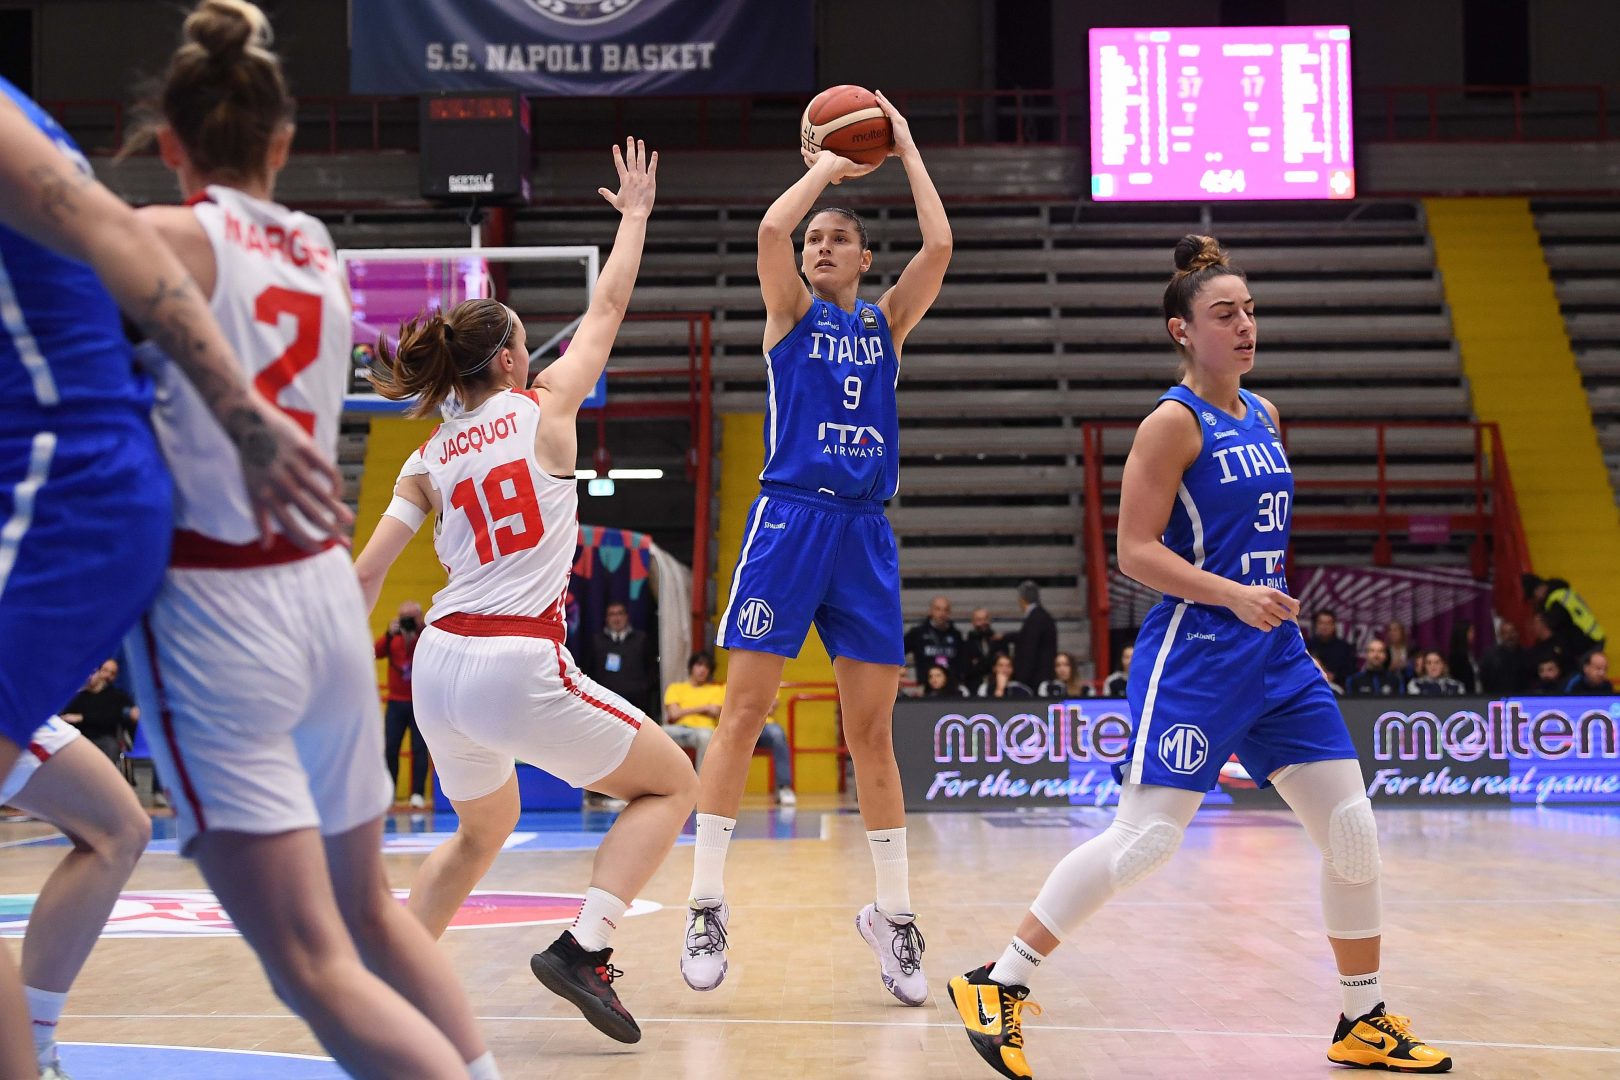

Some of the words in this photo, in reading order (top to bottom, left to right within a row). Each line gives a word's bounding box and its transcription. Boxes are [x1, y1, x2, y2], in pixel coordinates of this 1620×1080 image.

[426, 43, 476, 71] S.S.
[486, 43, 592, 73] NAPOLI
[601, 42, 716, 73] BASKET
[254, 285, 323, 438] 2
[808, 332, 884, 366] ITALIA
[842, 375, 862, 410] 9
[439, 412, 518, 465] JACQUOT
[818, 422, 885, 444] ITA
[822, 444, 883, 458] AIRWAYS
[1212, 441, 1292, 485] ITALI
[450, 457, 545, 566] 19
[1253, 490, 1290, 534] 30
[739, 600, 772, 637] MG
[934, 704, 1132, 765] molte
[1161, 726, 1206, 772] MG
[1373, 701, 1619, 762] molten
[926, 769, 978, 800] For
[978, 768, 1031, 798] the
[1030, 769, 1097, 798] real
[1366, 767, 1419, 799] For
[1418, 766, 1472, 796] the
[1471, 765, 1538, 796] real
[1535, 774, 1620, 805] game
